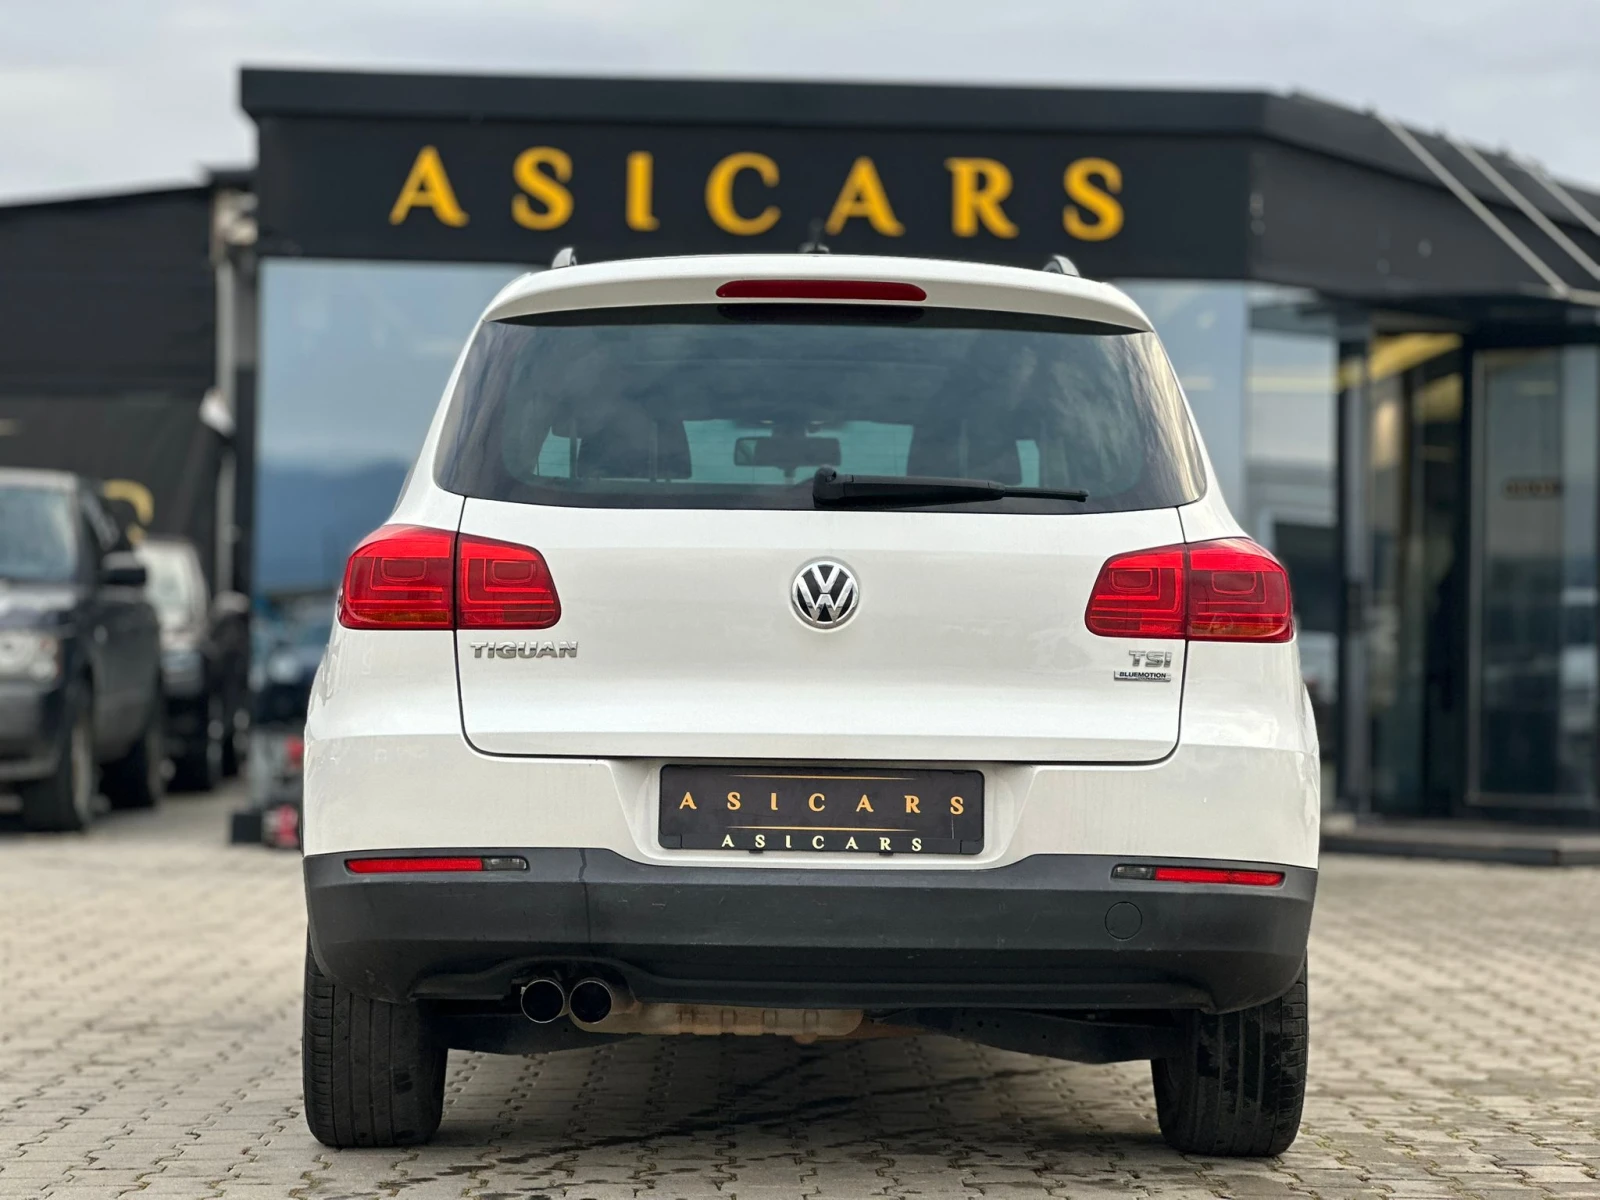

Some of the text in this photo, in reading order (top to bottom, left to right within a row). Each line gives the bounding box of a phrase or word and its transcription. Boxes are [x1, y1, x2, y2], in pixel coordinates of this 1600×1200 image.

[390, 145, 1125, 242] ASICARS
[470, 640, 579, 660] TIGUAN
[1128, 650, 1173, 668] TSI
[679, 791, 965, 815] ASICARS
[720, 834, 922, 852] ASICARS
